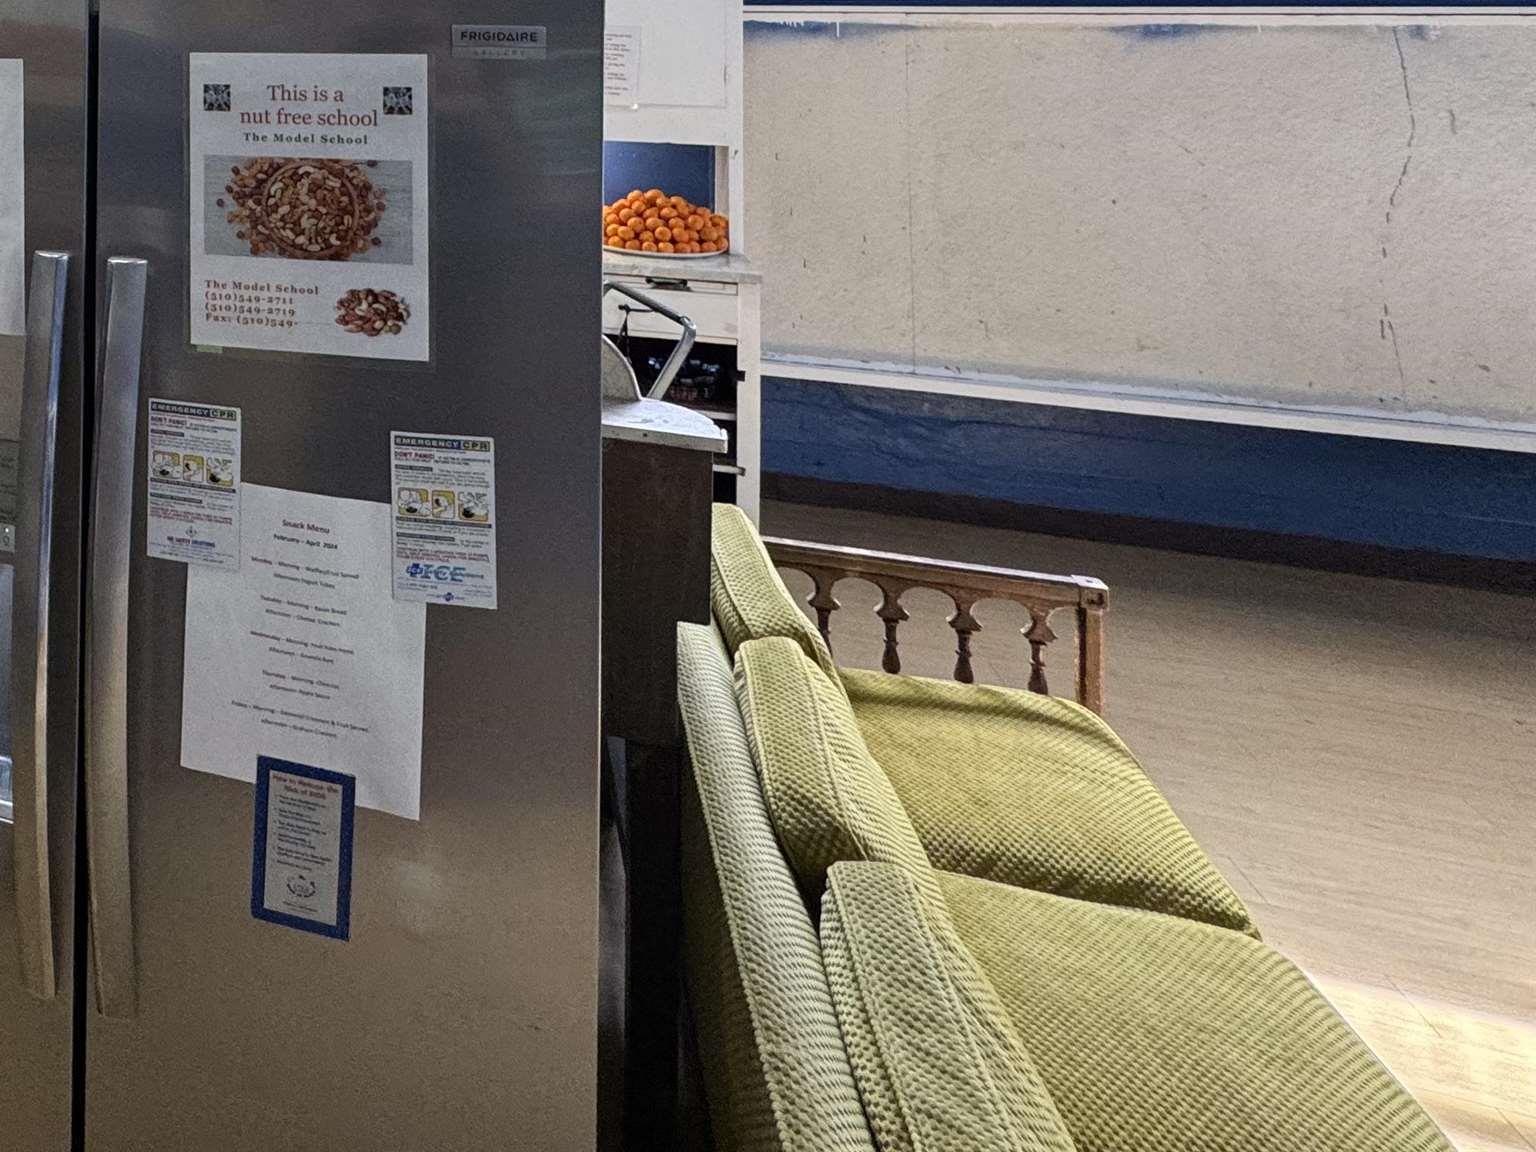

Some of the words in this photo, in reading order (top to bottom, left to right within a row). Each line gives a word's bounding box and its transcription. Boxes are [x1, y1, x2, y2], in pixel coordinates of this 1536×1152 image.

[460, 31, 538, 42] FRIGIDAIRE
[266, 83, 308, 102] This
[313, 84, 329, 102] is
[333, 88, 345, 103] a
[240, 109, 272, 125] nut
[276, 107, 313, 126] free
[316, 108, 378, 127] school
[244, 132, 269, 143] The
[273, 133, 316, 144] Model
[320, 134, 369, 145] School
[204, 279, 228, 290] The
[232, 280, 271, 293] Model
[275, 283, 320, 296] School
[151, 402, 210, 416] EMERGENCY
[395, 436, 459, 449] EMERGENCY
[282, 519, 305, 530] Snack
[306, 523, 330, 534] Menu
